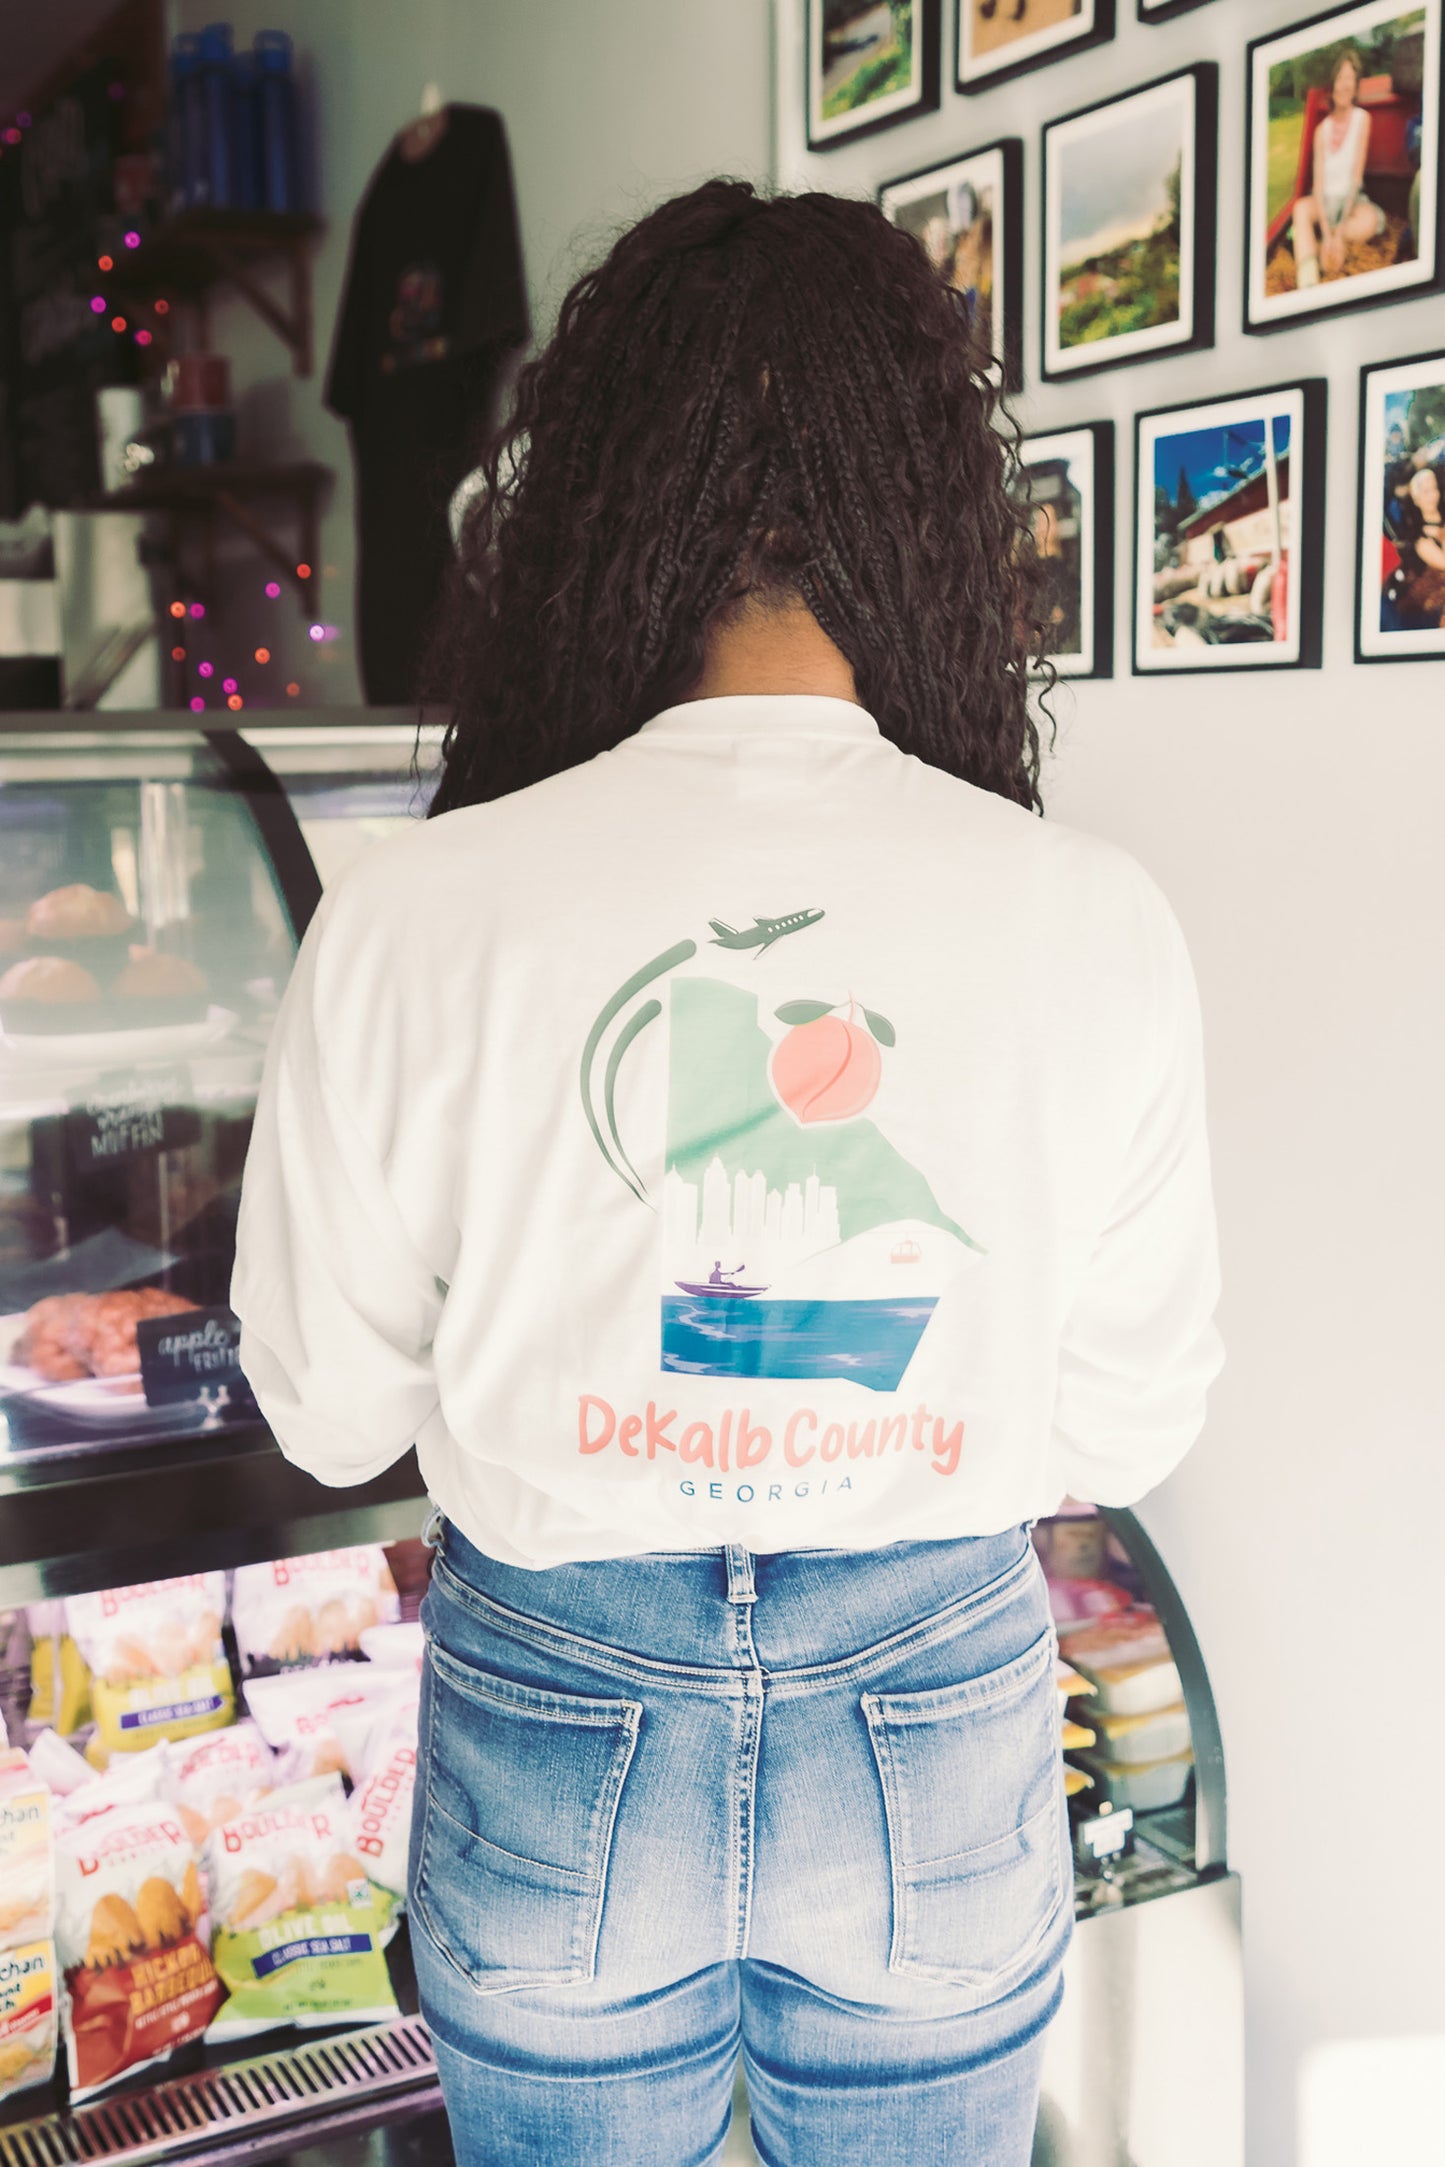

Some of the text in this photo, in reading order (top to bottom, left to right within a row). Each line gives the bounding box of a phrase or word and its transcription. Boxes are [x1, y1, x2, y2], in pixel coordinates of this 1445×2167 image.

[158, 1319, 230, 1368] apple
[578, 1394, 965, 1476] DeKalb County
[679, 1476, 854, 1504] GEORGIA
